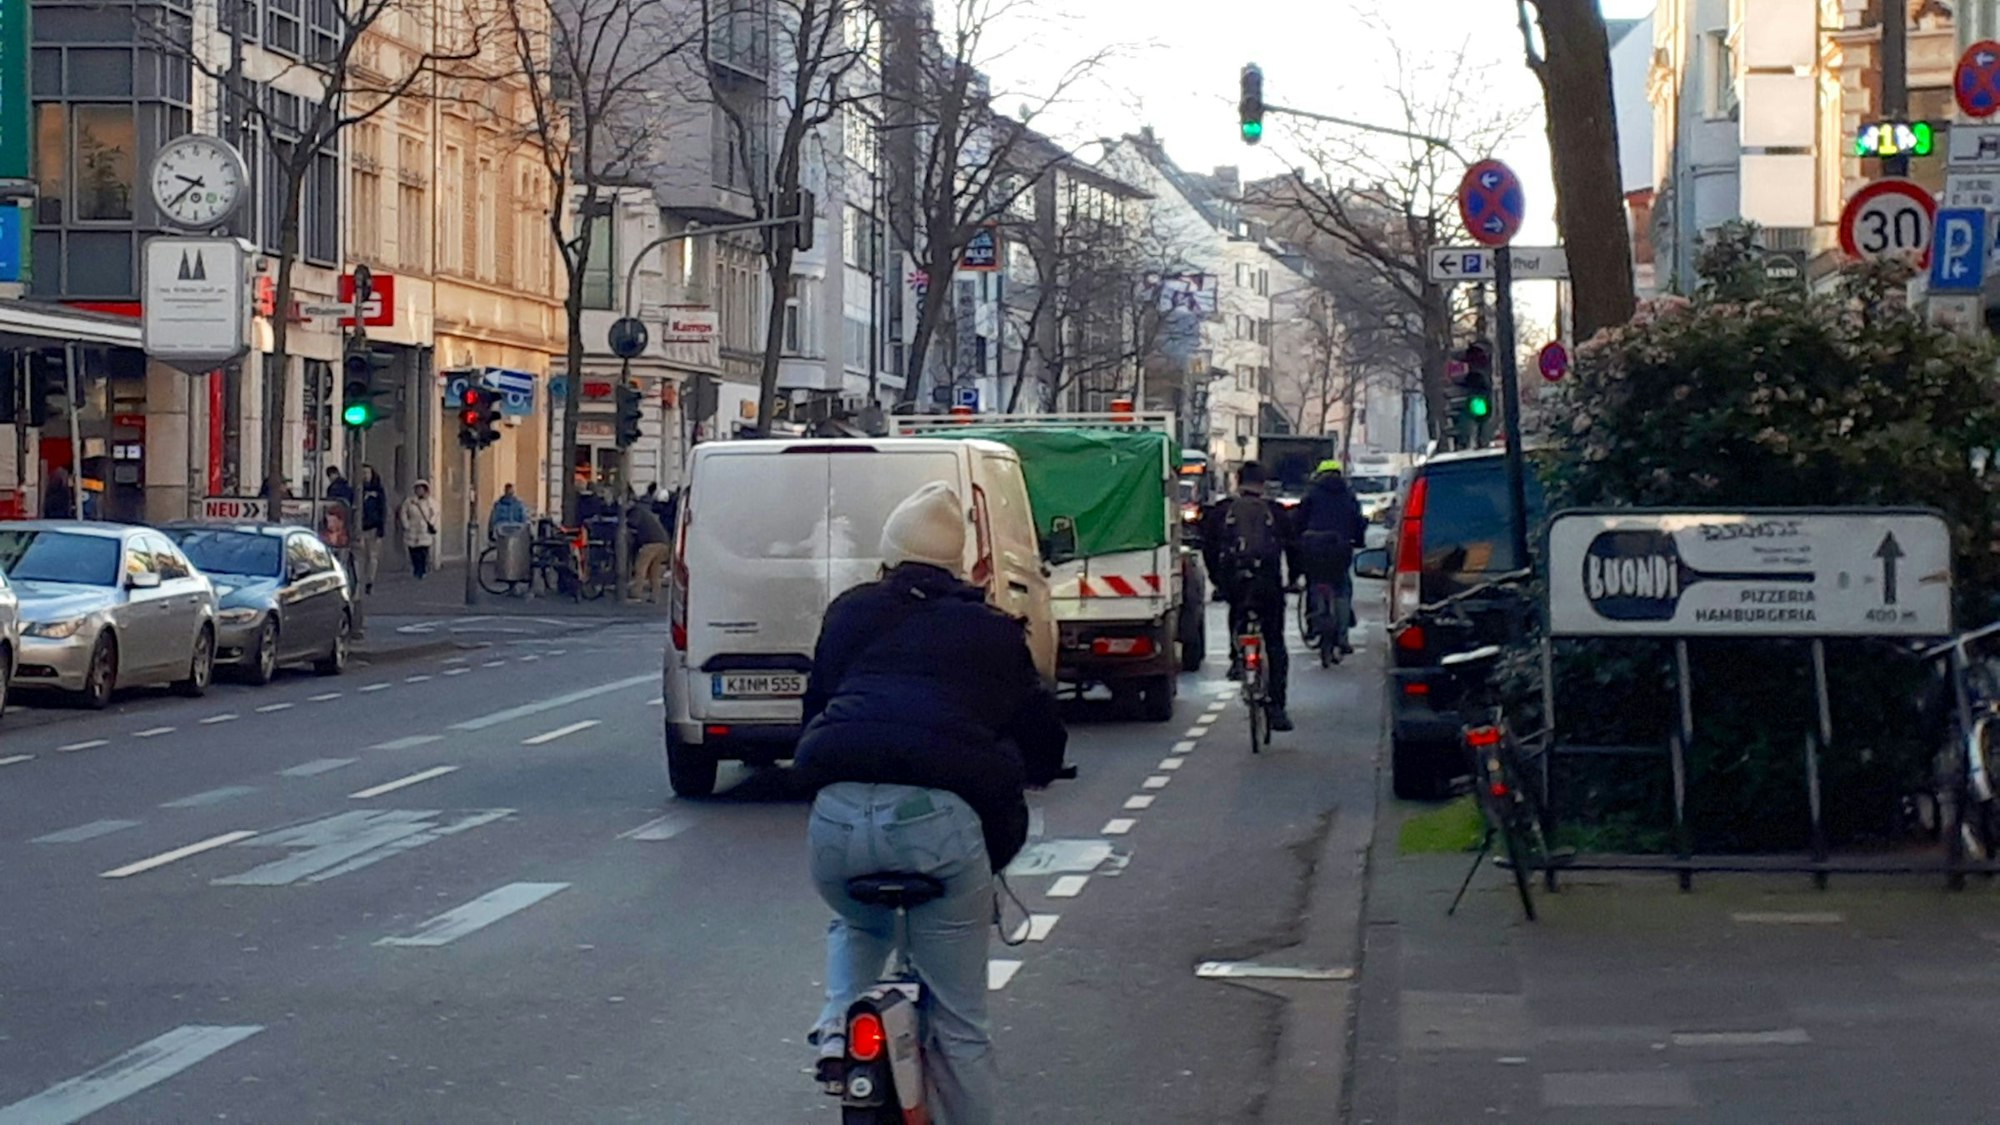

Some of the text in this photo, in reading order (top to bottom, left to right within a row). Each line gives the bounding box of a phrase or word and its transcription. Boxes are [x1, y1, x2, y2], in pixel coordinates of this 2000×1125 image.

[1862, 207, 1922, 252] 30
[1941, 218, 1973, 280] P
[672, 320, 713, 332] Kamps
[206, 502, 239, 517] NEU
[1741, 589, 1815, 603] PIZZERIA
[1696, 608, 1817, 622] HAMBURGERIA
[1865, 608, 1898, 622] 400
